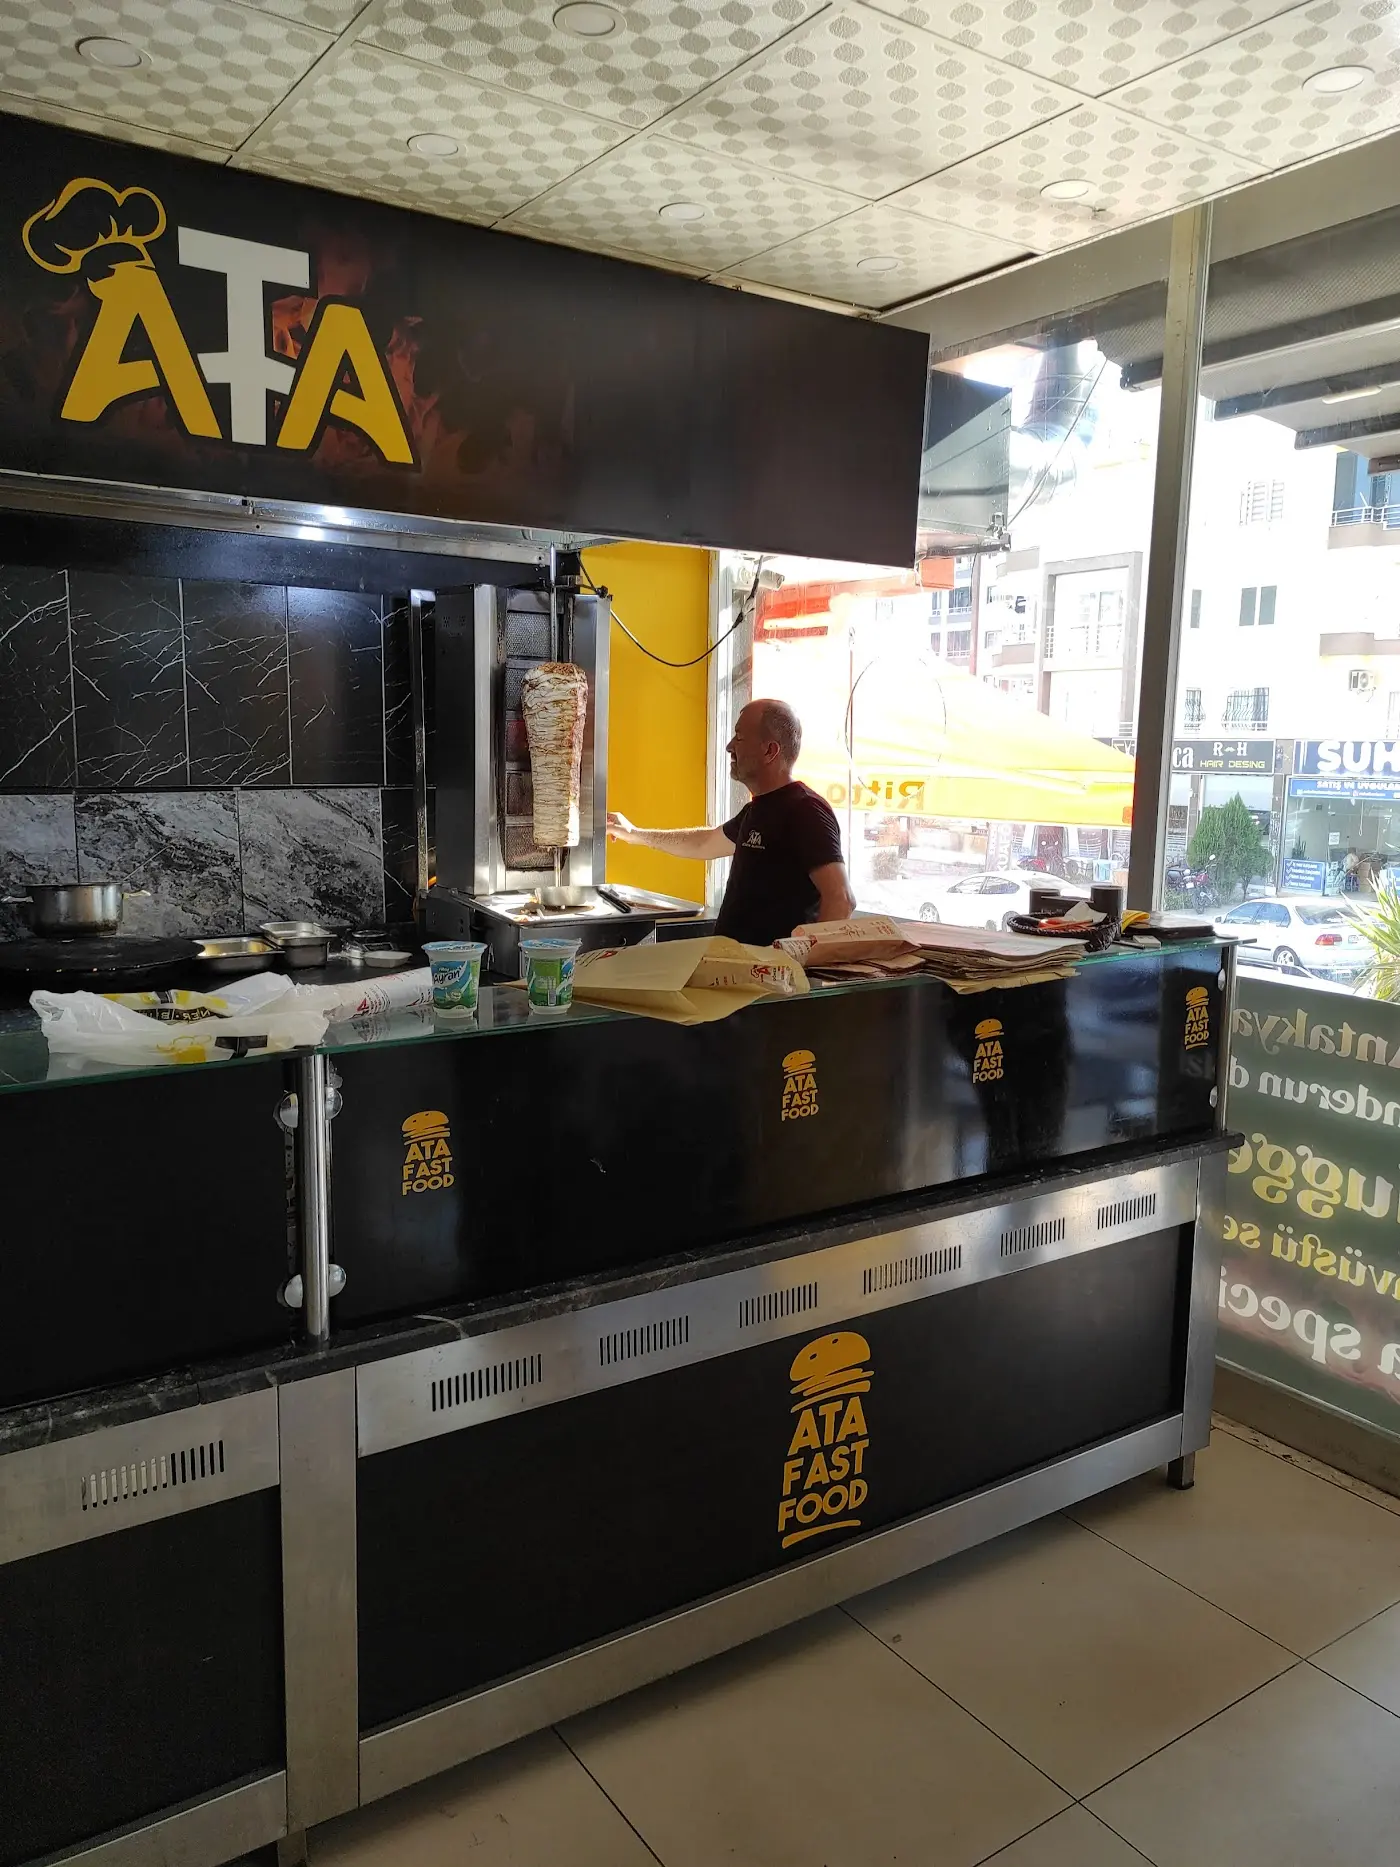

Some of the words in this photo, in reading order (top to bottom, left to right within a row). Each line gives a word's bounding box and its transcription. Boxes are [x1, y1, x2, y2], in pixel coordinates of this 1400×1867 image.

[60, 226, 414, 465] ATA
[1200, 760, 1224, 768] HAIR
[1228, 760, 1266, 769] DESING
[433, 968, 461, 985] Ayran
[1186, 1006, 1209, 1023] ATA
[1185, 1019, 1210, 1035] FAST
[1184, 1031, 1210, 1045] FOOD
[975, 1040, 1003, 1059] ATA
[974, 1055, 1004, 1072] FAST
[784, 1074, 817, 1094] ATA
[973, 1068, 1004, 1083] FOOD
[782, 1089, 818, 1108] FAST
[781, 1104, 819, 1121] FOOD
[405, 1139, 451, 1164] ATA
[403, 1157, 453, 1180] FAST
[402, 1174, 455, 1195] FOOD
[787, 1396, 868, 1456] ATA
[782, 1439, 870, 1496] FAST
[778, 1478, 868, 1532] FOOD
